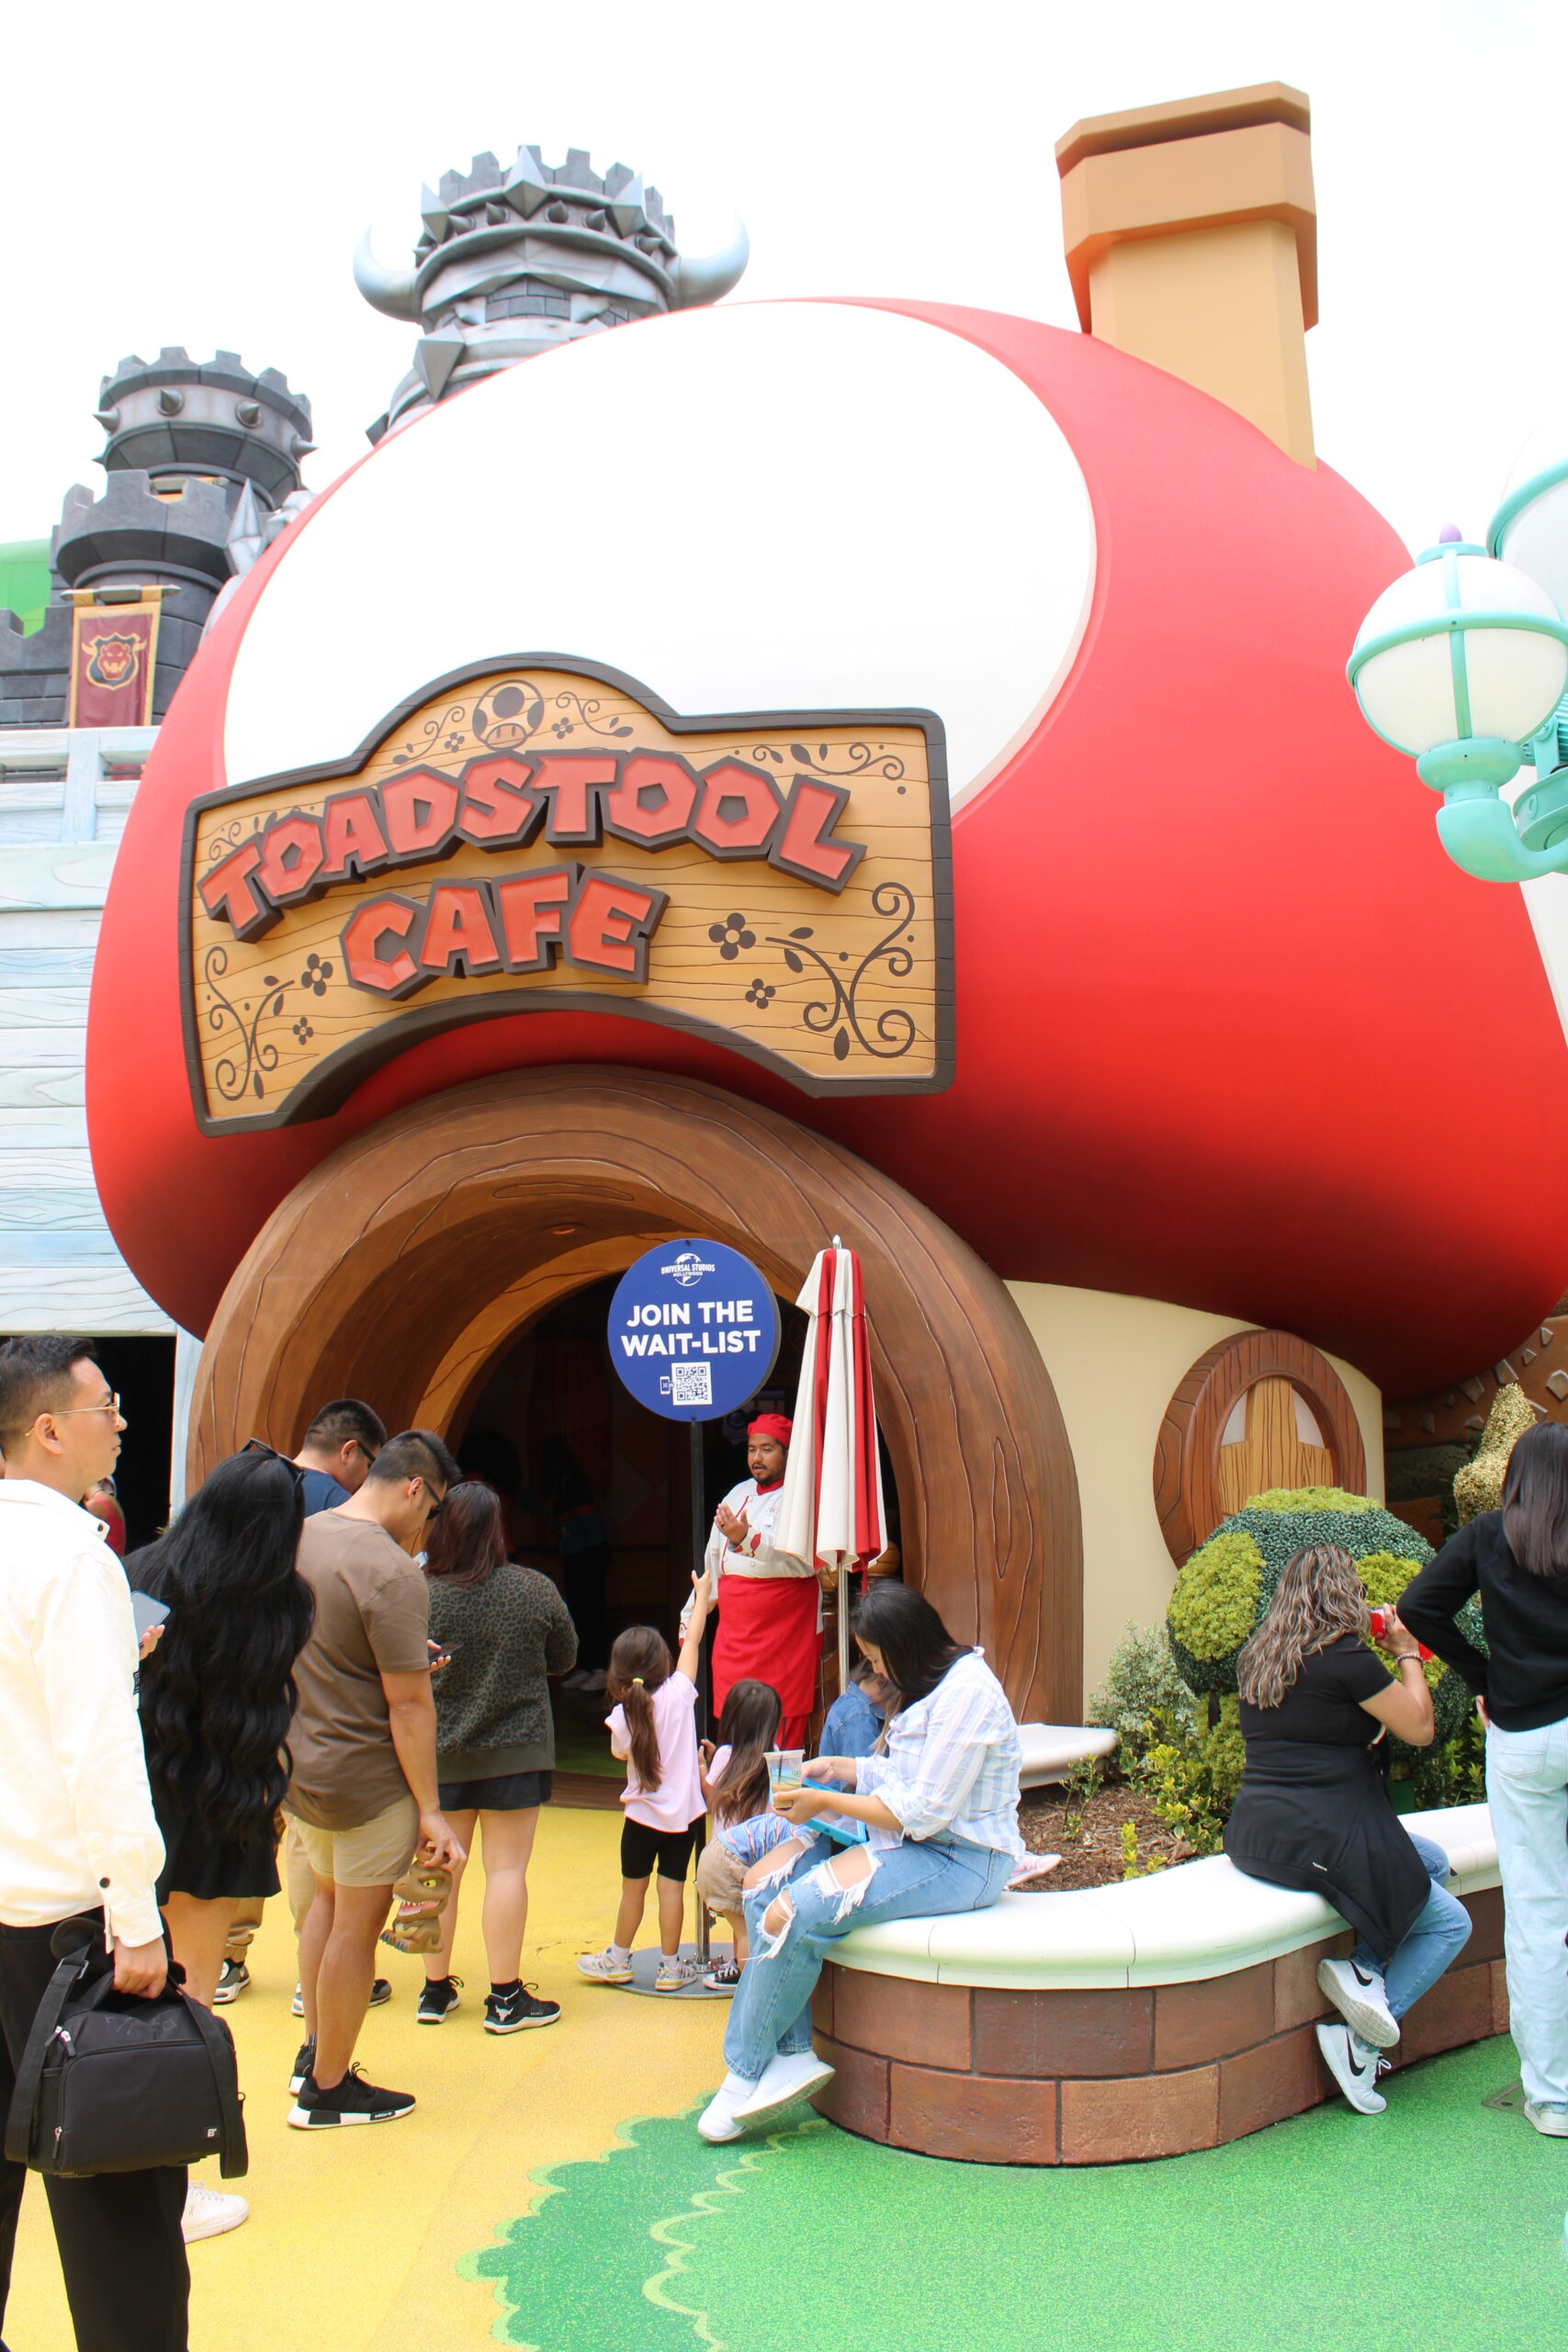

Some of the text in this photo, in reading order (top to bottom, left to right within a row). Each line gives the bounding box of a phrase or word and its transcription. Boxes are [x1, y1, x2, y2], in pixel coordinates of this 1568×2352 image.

[197, 748, 866, 942] TOADSTOOL
[338, 862, 671, 1001] CAFE
[660, 1263, 716, 1274] UNIVERSAL STUDIOS
[626, 1300, 753, 1327] JOIN THE
[621, 1330, 761, 1357] WAIT-LIST
